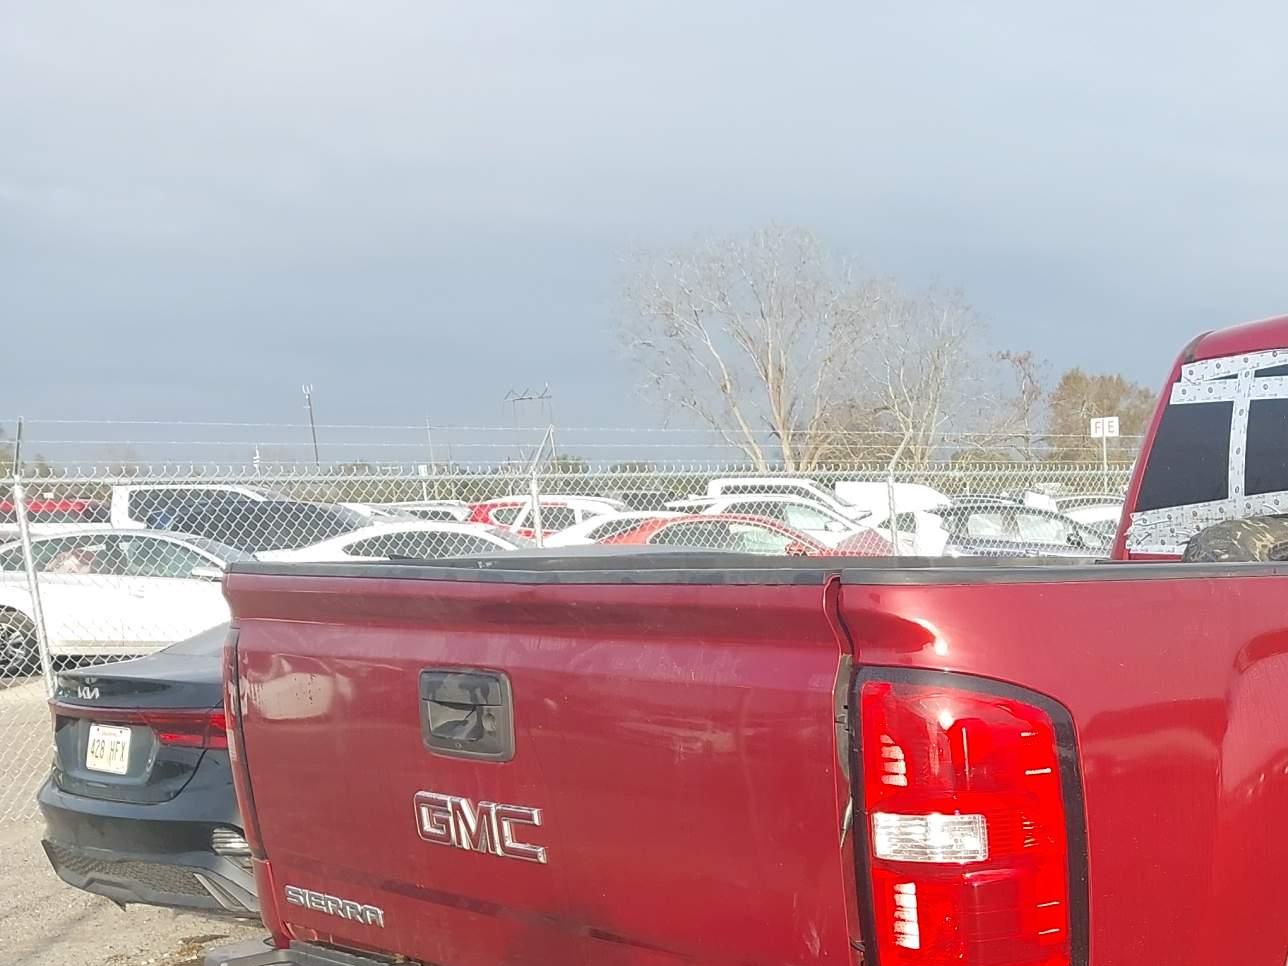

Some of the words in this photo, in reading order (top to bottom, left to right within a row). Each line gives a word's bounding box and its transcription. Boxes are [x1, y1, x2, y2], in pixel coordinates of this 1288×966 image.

[1107, 420, 1115, 433] E
[78, 683, 99, 699] KIA
[413, 790, 548, 864] GMC
[284, 884, 384, 928] SIERRA
